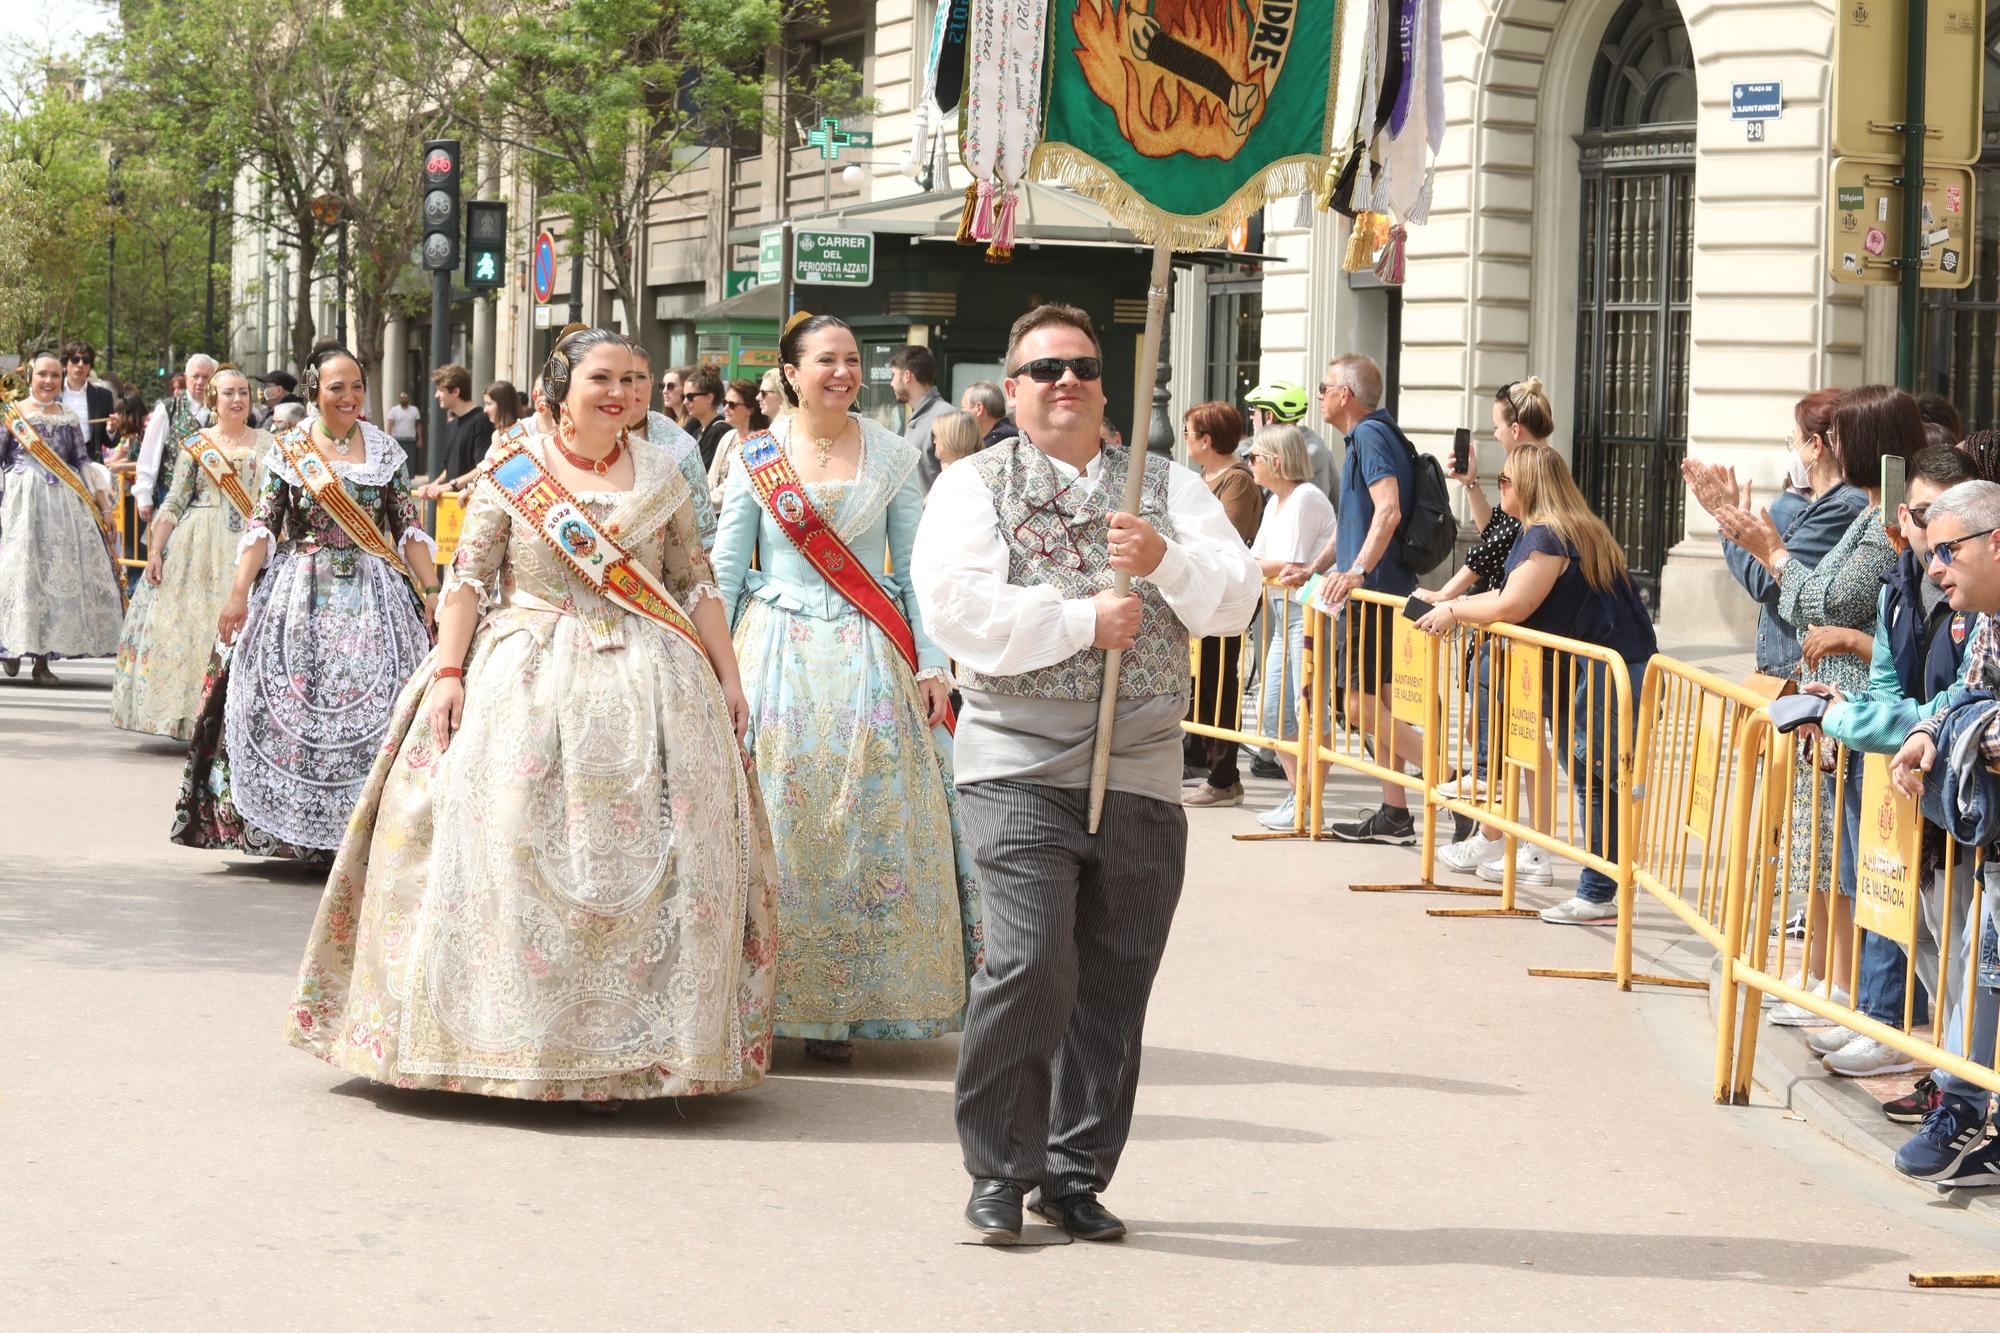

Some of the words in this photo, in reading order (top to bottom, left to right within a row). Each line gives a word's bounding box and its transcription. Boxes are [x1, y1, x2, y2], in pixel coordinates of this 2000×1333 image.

[1250, 0, 1293, 69] DRE
[1732, 103, 1780, 113] L'AJUNTAMENT
[1748, 122, 1762, 139] 29
[817, 236, 866, 248] CARRER
[823, 250, 842, 259] DEL
[798, 261, 842, 273] PERIODISTA
[842, 262, 868, 274] AZZATI
[547, 507, 571, 530] 2022
[1394, 673, 1423, 689] AJUNTAMENT
[1394, 688, 1401, 699] DE
[1510, 723, 1517, 736] DE
[1862, 852, 1908, 884] AJUNTAMENT
[1861, 876, 1871, 896] DE
